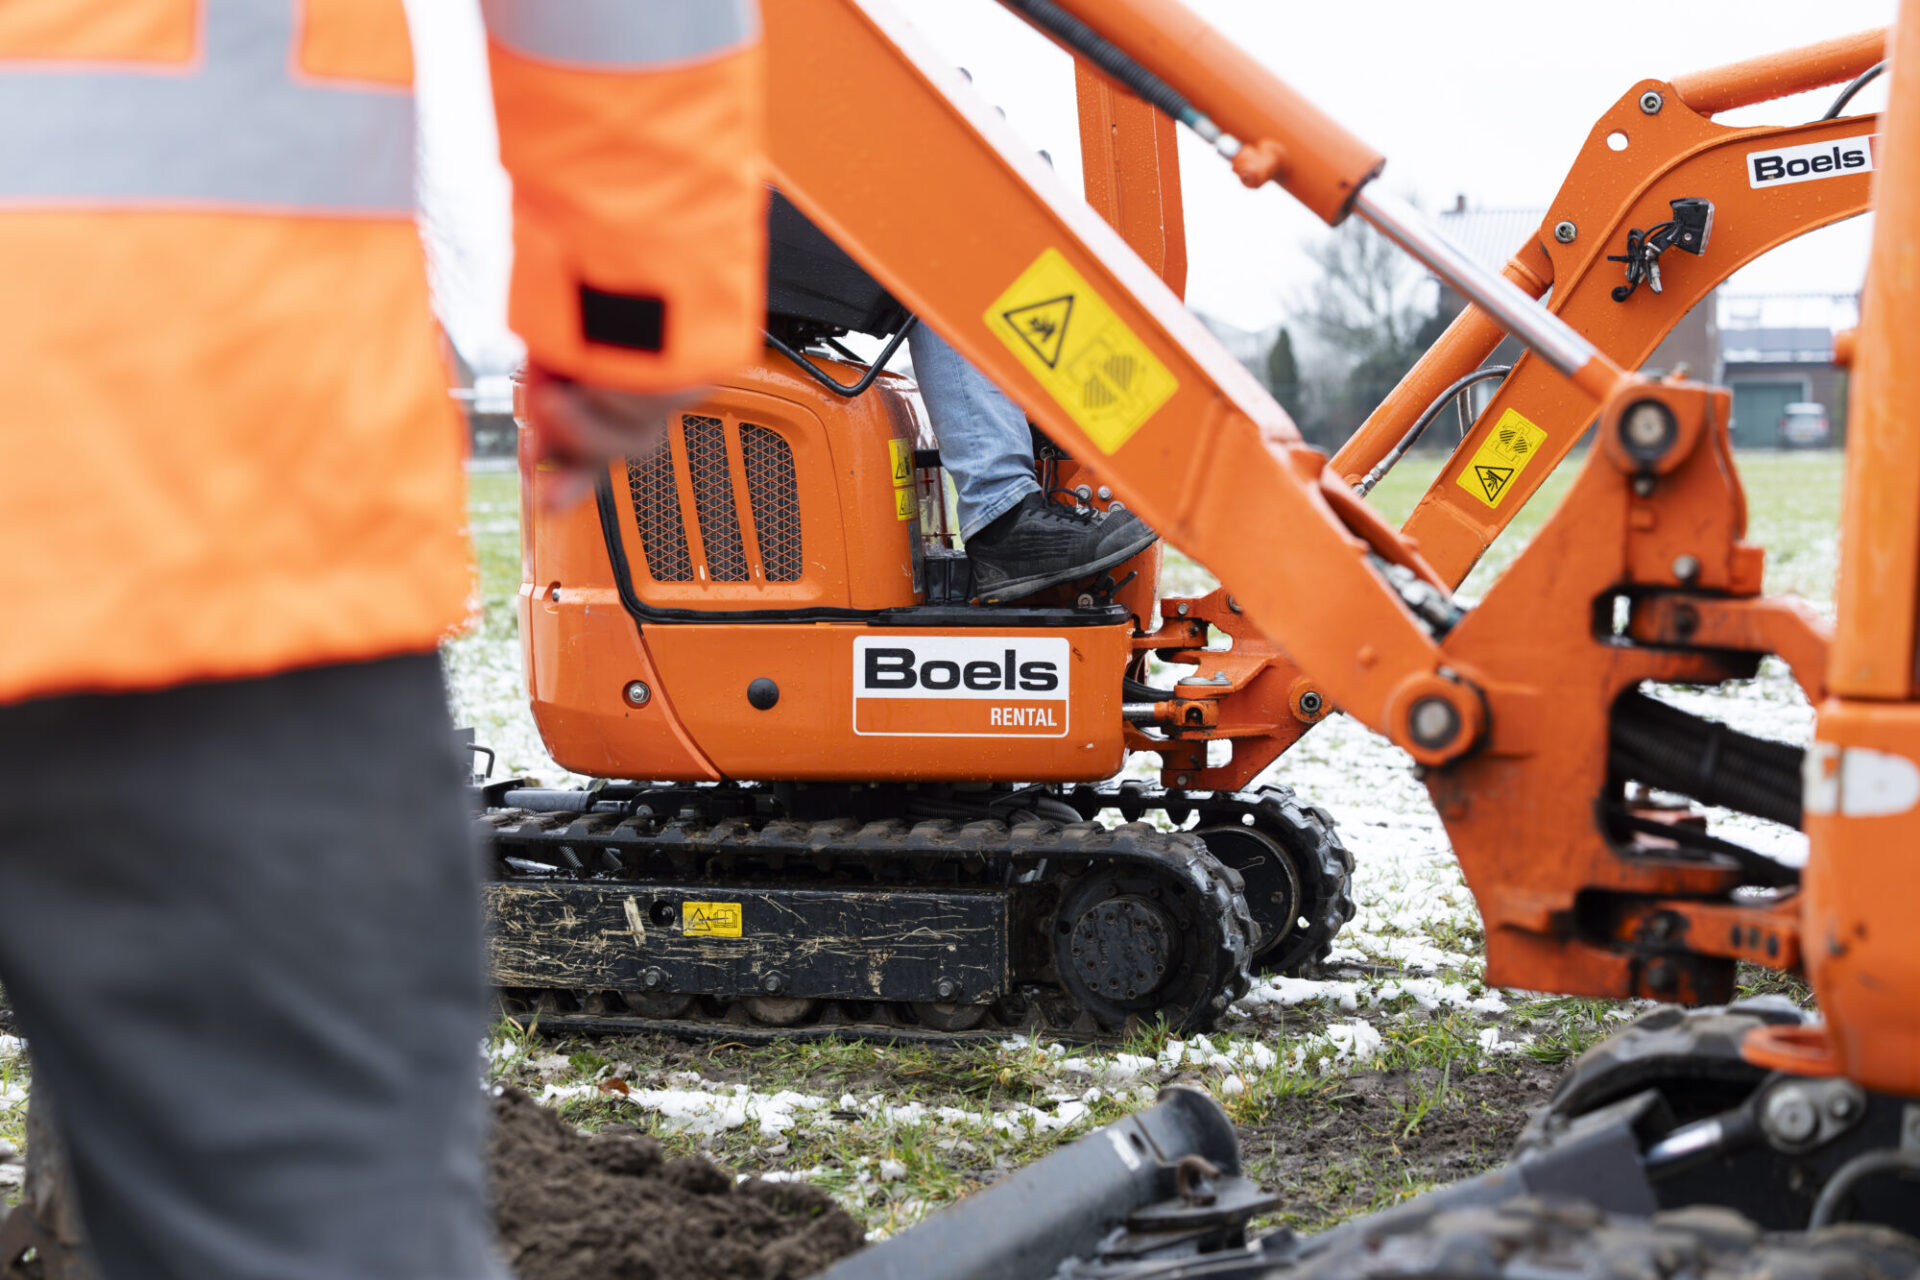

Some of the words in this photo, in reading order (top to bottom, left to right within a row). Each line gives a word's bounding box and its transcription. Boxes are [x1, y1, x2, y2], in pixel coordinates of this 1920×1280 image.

[1753, 146, 1866, 182] Boels
[864, 647, 1059, 692] Boels
[990, 707, 1058, 727] RENTAL
